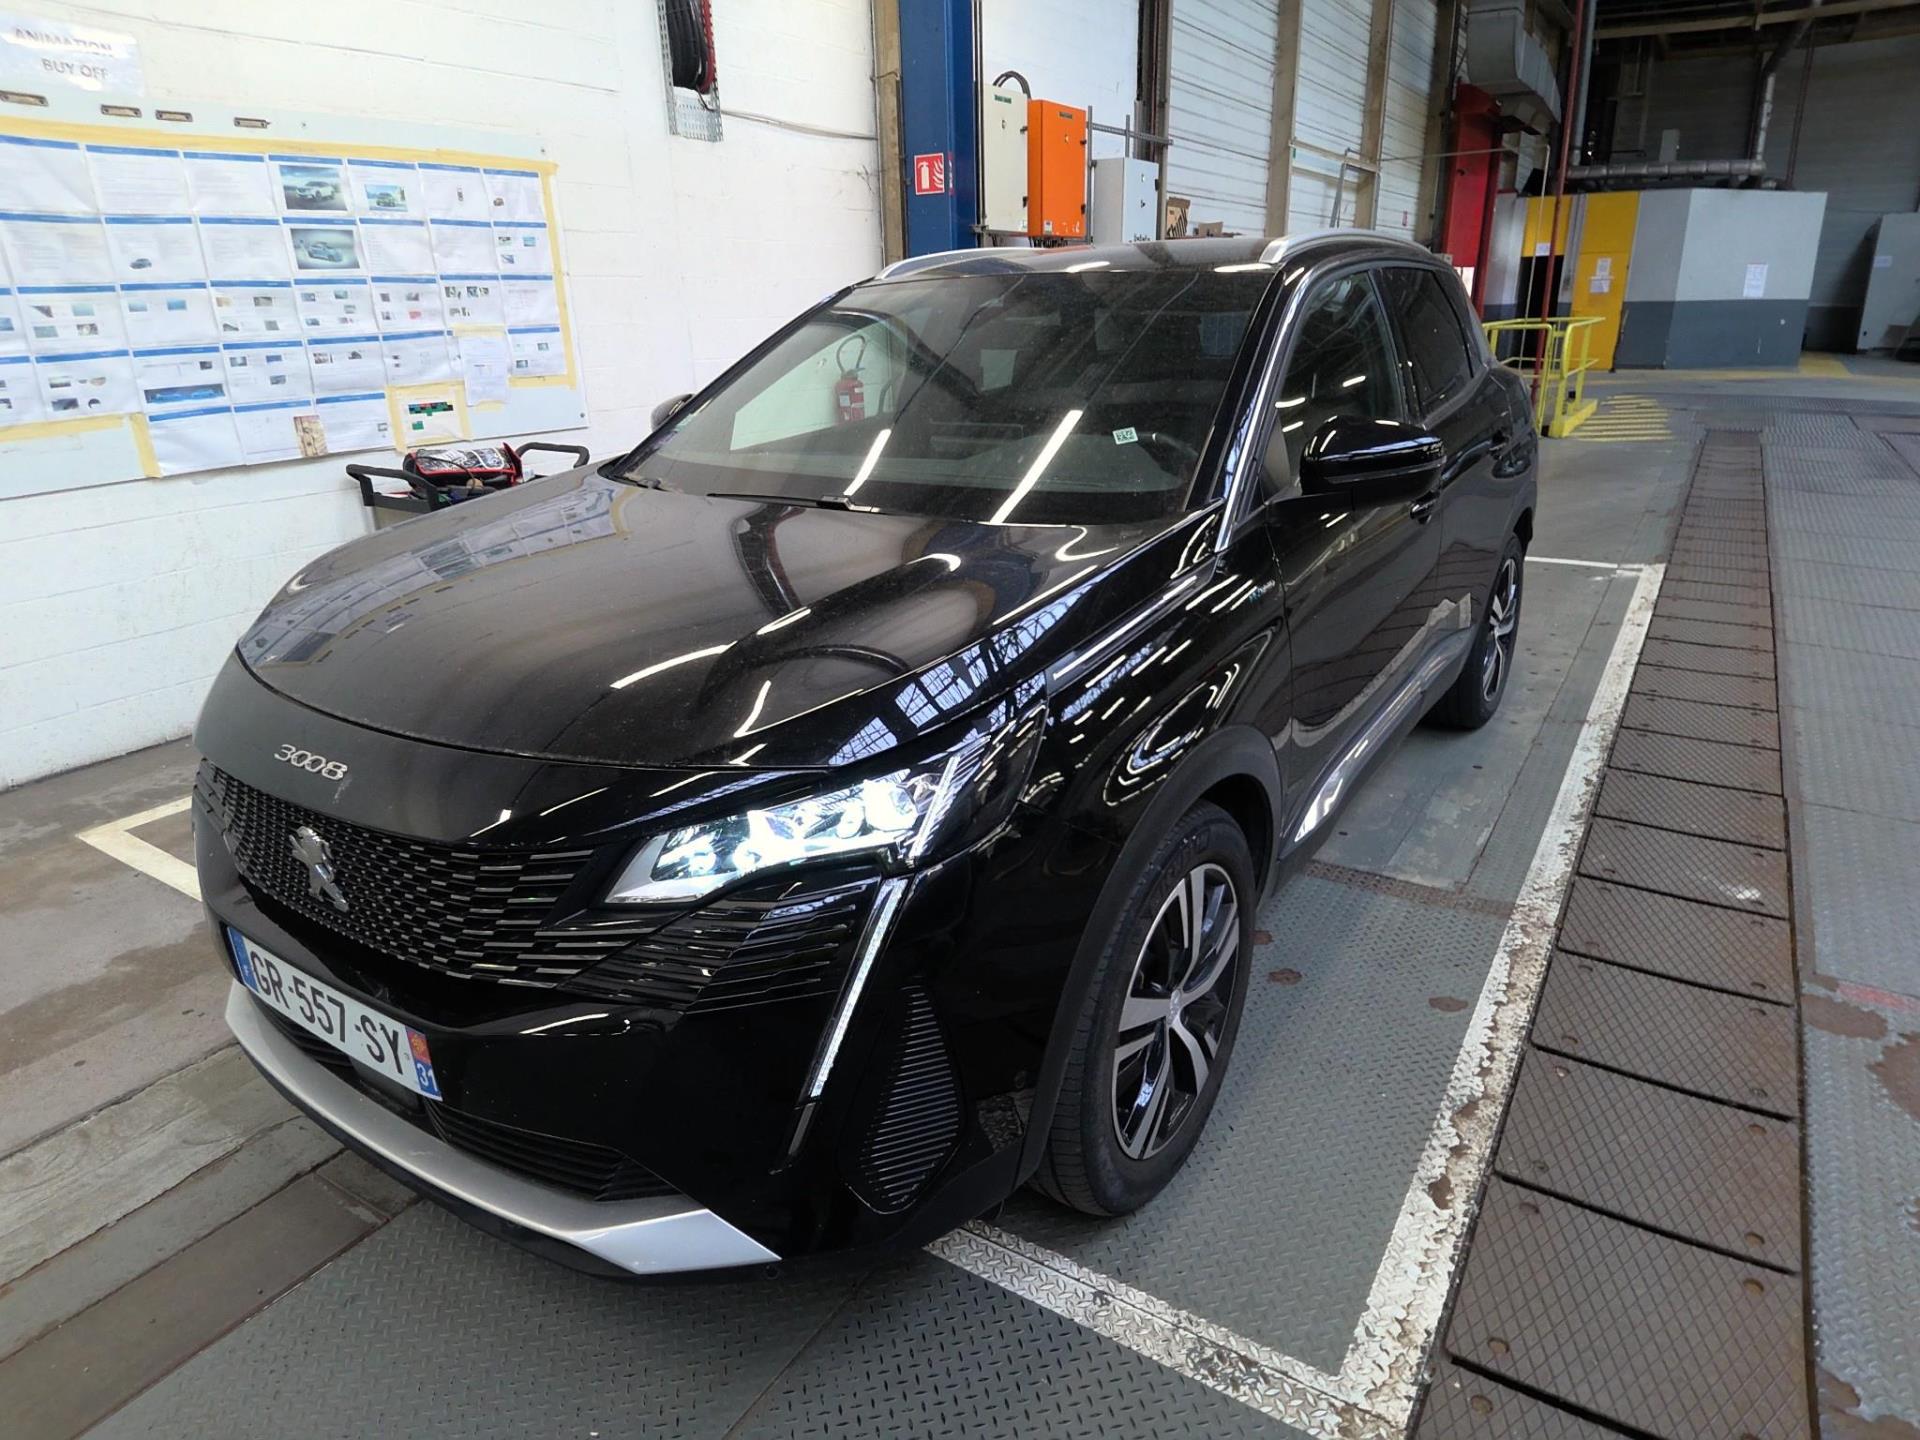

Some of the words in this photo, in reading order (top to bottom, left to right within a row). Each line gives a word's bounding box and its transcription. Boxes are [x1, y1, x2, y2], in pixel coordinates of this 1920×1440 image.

[42, 58, 74, 74] BUY
[80, 64, 108, 79] OFF
[274, 744, 348, 780] 3008
[251, 950, 404, 1075] GR-557-SY
[416, 1063, 439, 1092] 31
